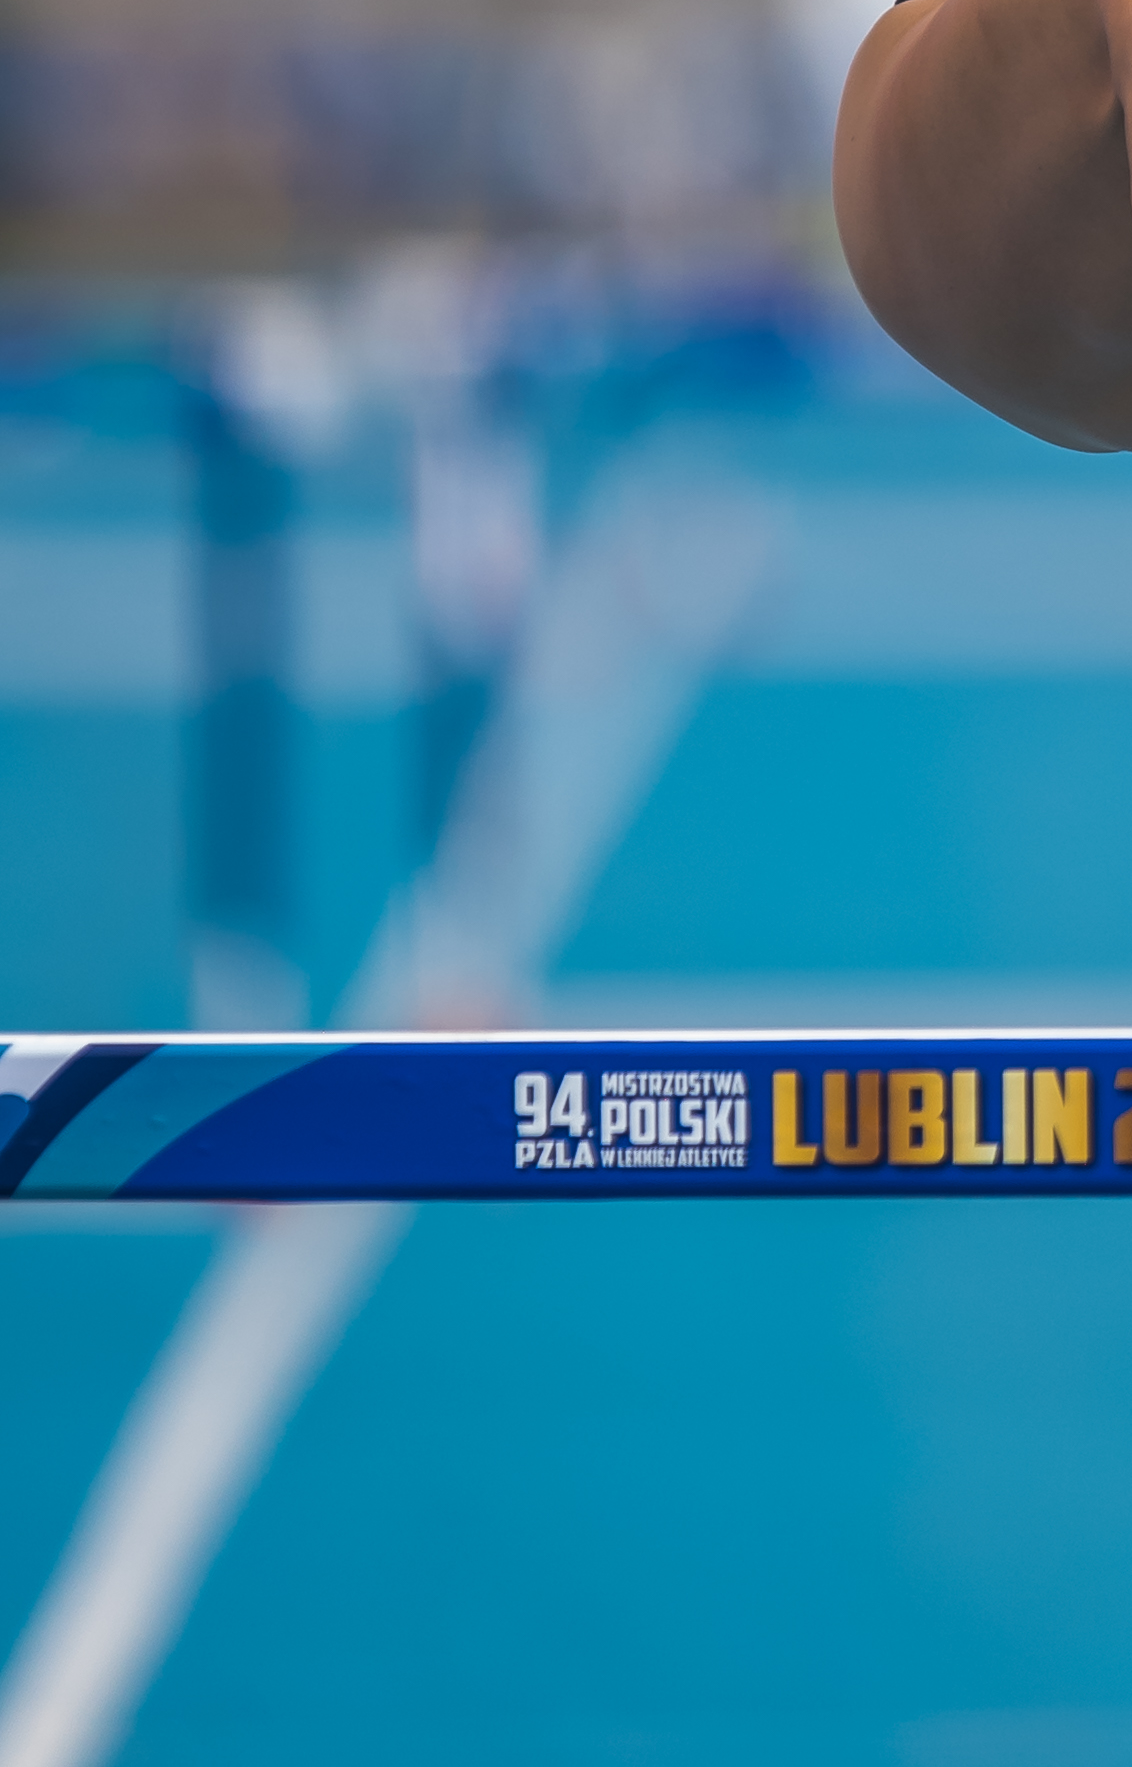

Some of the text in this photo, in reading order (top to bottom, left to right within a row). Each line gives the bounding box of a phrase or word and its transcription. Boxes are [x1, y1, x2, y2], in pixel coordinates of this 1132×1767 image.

[601, 1071, 745, 1096] MISTRZOSTWA
[514, 1071, 595, 1138] 94.
[601, 1098, 747, 1145] POLSKI
[772, 1068, 1090, 1165] LUBLIN
[515, 1139, 595, 1169] PZLA
[601, 1147, 614, 1167] W
